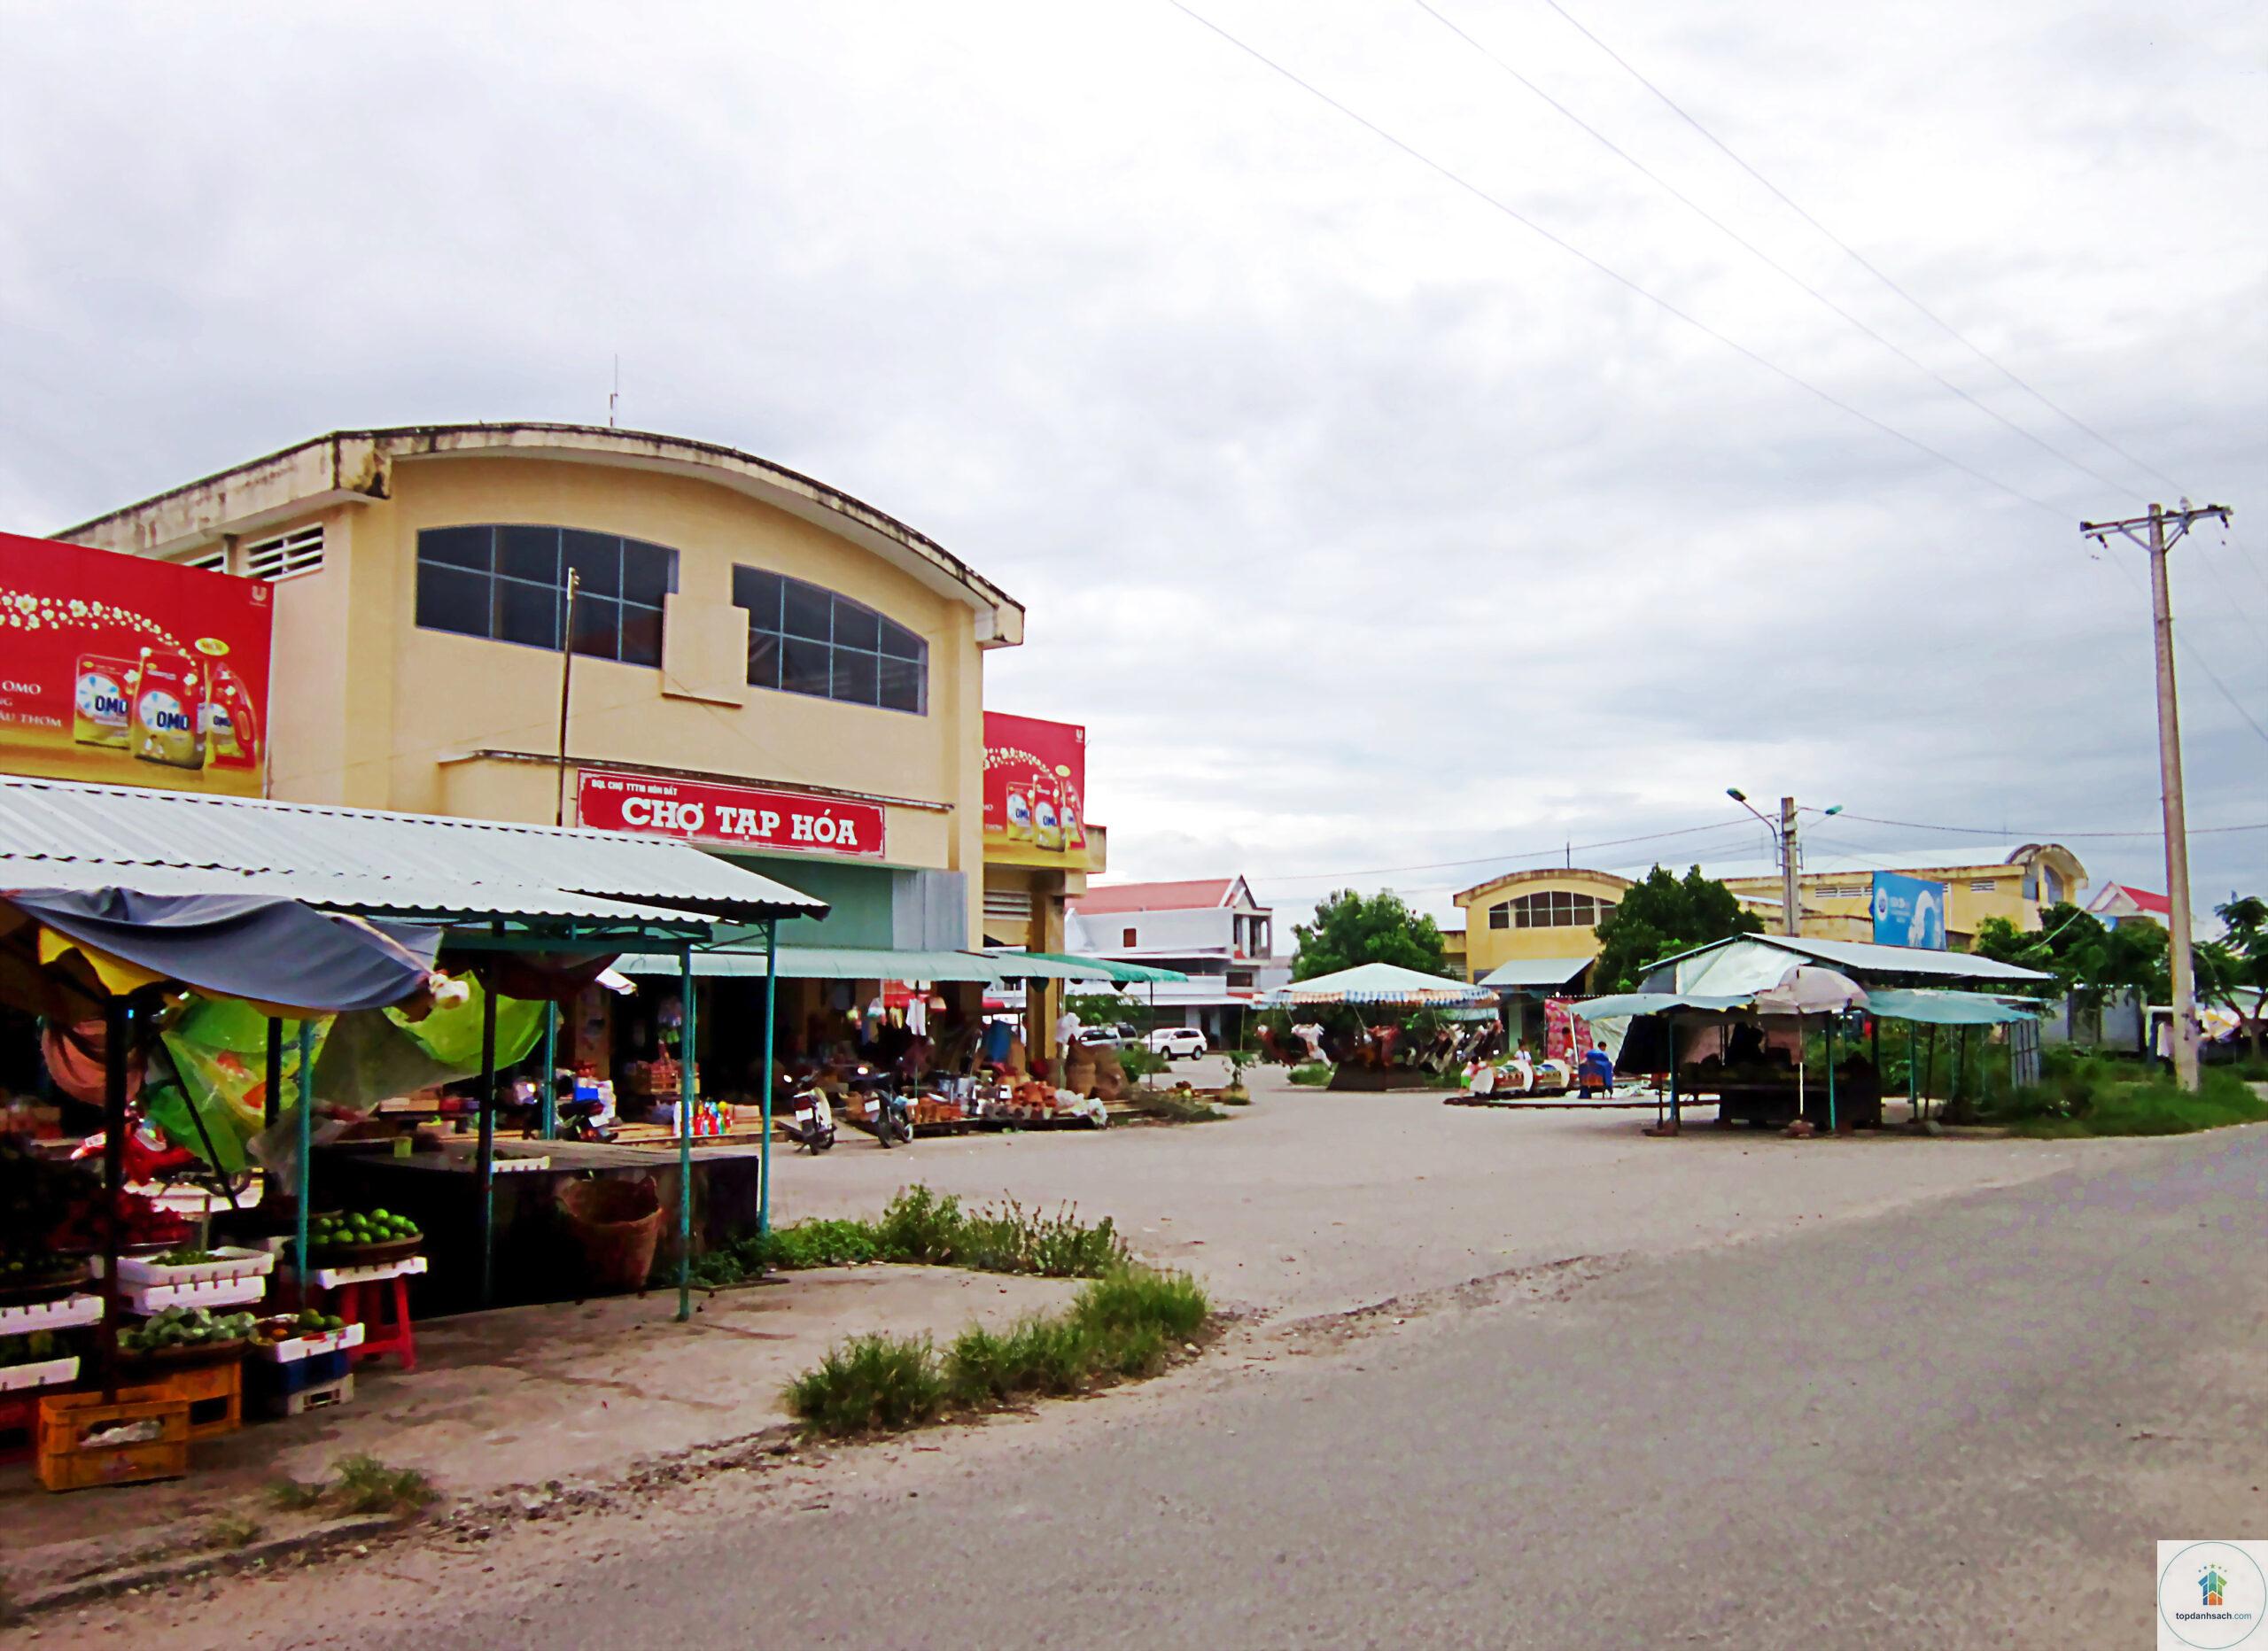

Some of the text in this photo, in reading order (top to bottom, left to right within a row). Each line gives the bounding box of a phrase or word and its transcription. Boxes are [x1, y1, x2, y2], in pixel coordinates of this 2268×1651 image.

[2, 680, 42, 694] OMO
[95, 695, 128, 714] OMO
[157, 711, 190, 731] OMO
[622, 797, 858, 845] CHỢ TẠP HÓA
